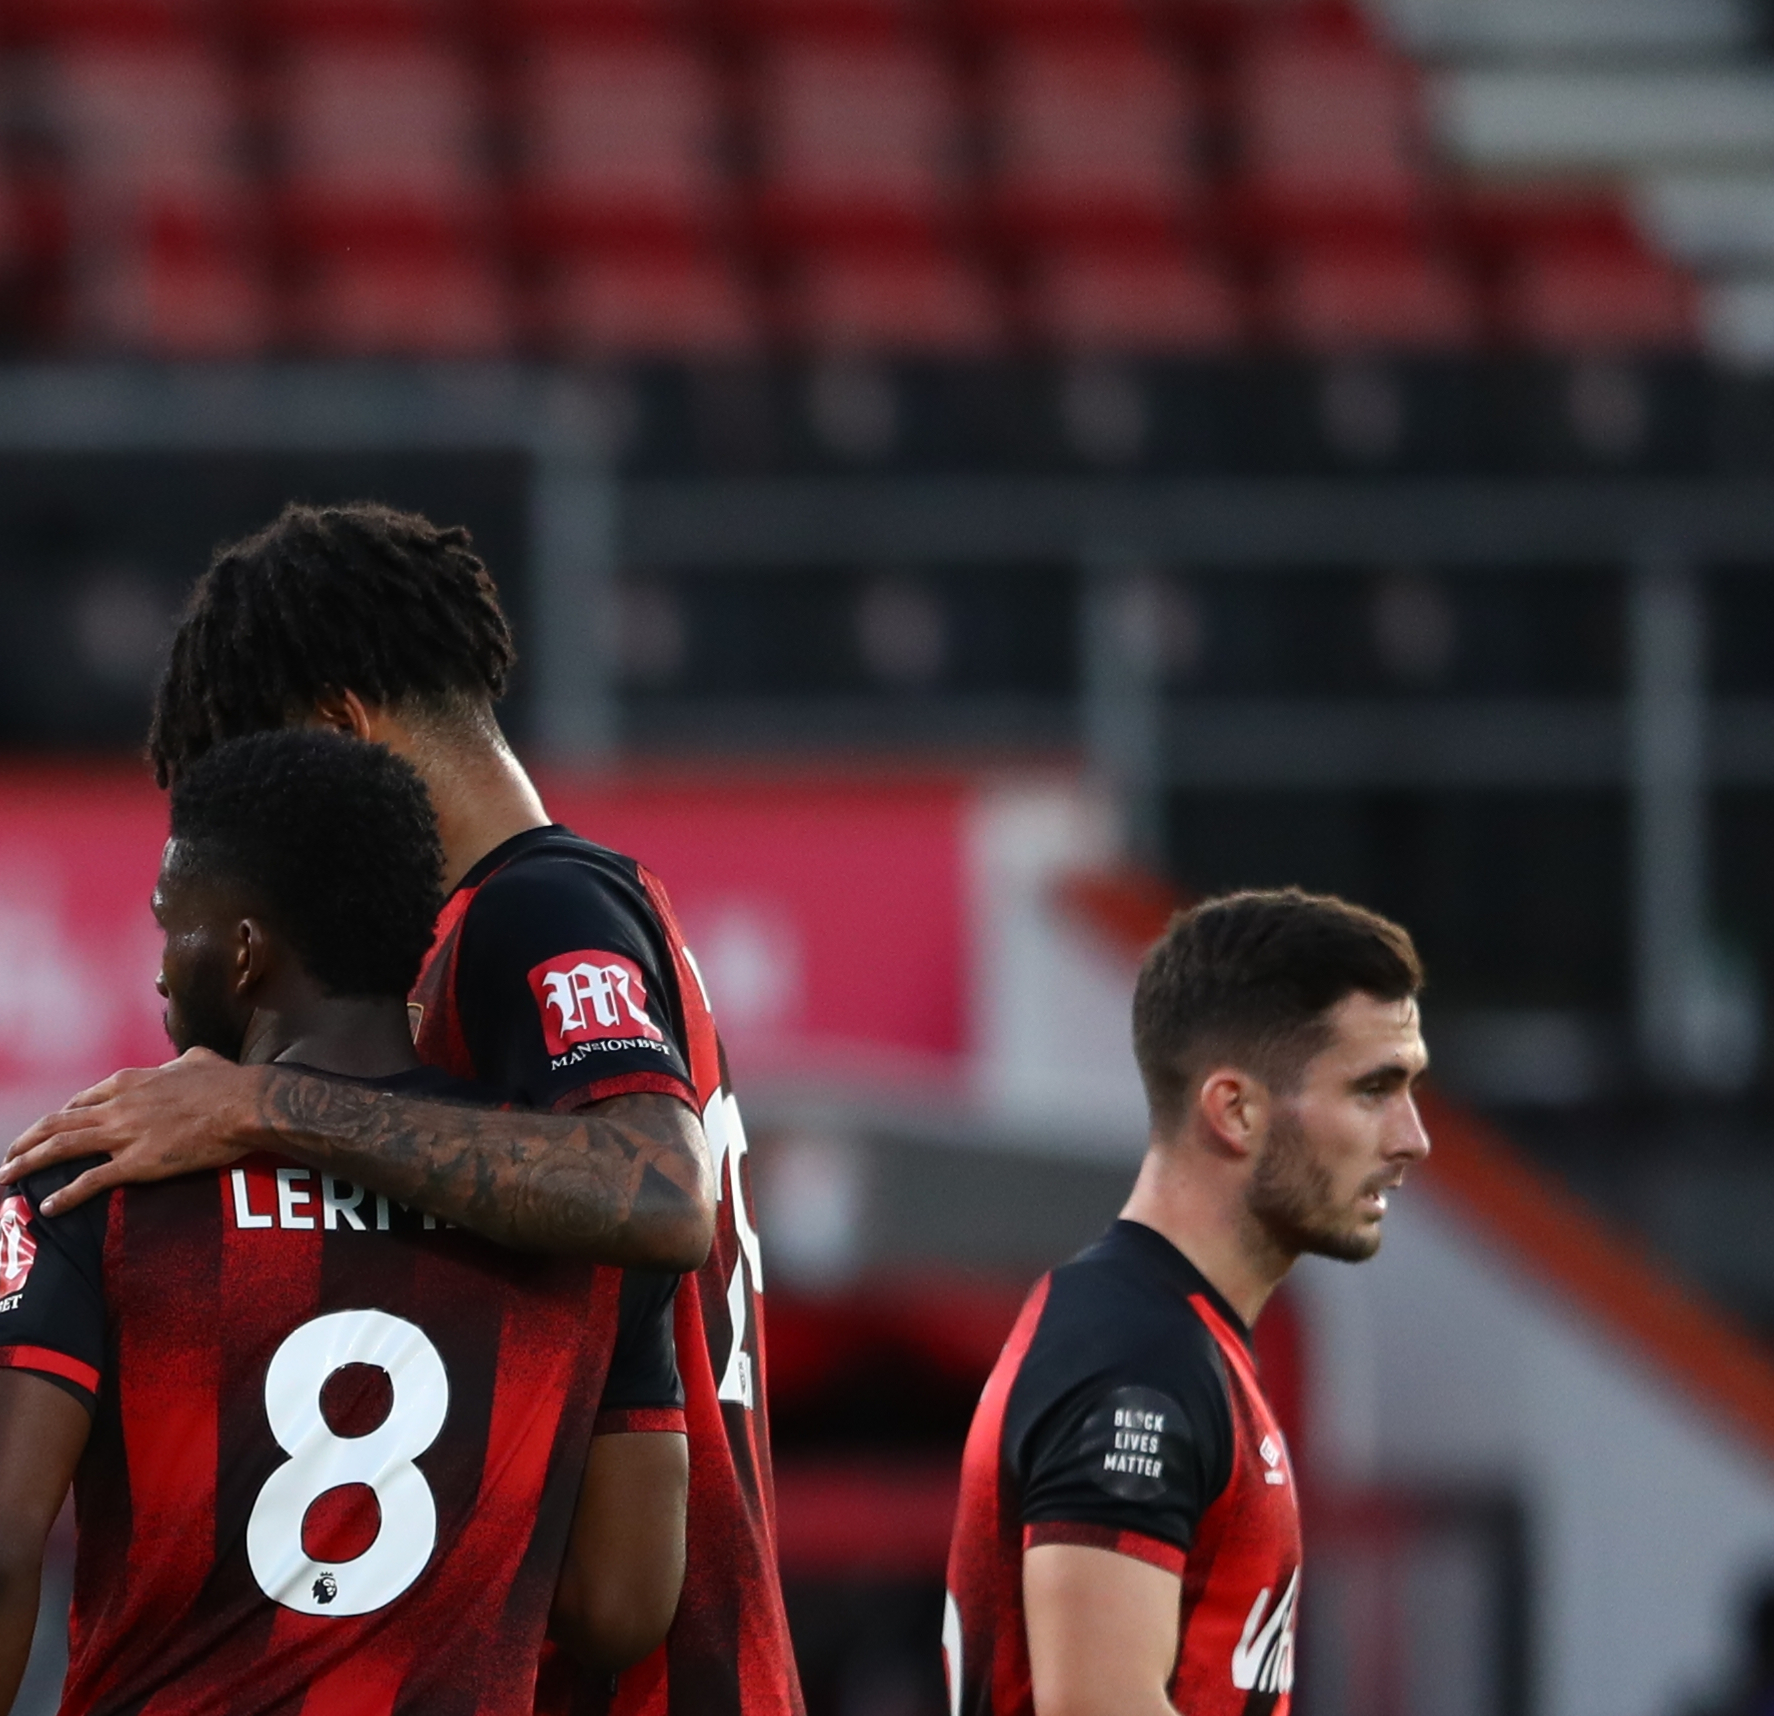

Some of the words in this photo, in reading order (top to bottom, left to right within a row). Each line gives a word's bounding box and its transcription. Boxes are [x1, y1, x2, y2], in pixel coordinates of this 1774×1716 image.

[231, 1168, 457, 1231] LER
[1114, 1409, 1165, 1433] BLCK
[1114, 1431, 1159, 1454] LIVES
[246, 1308, 449, 1617] 8
[1103, 1453, 1163, 1479] MATTER
